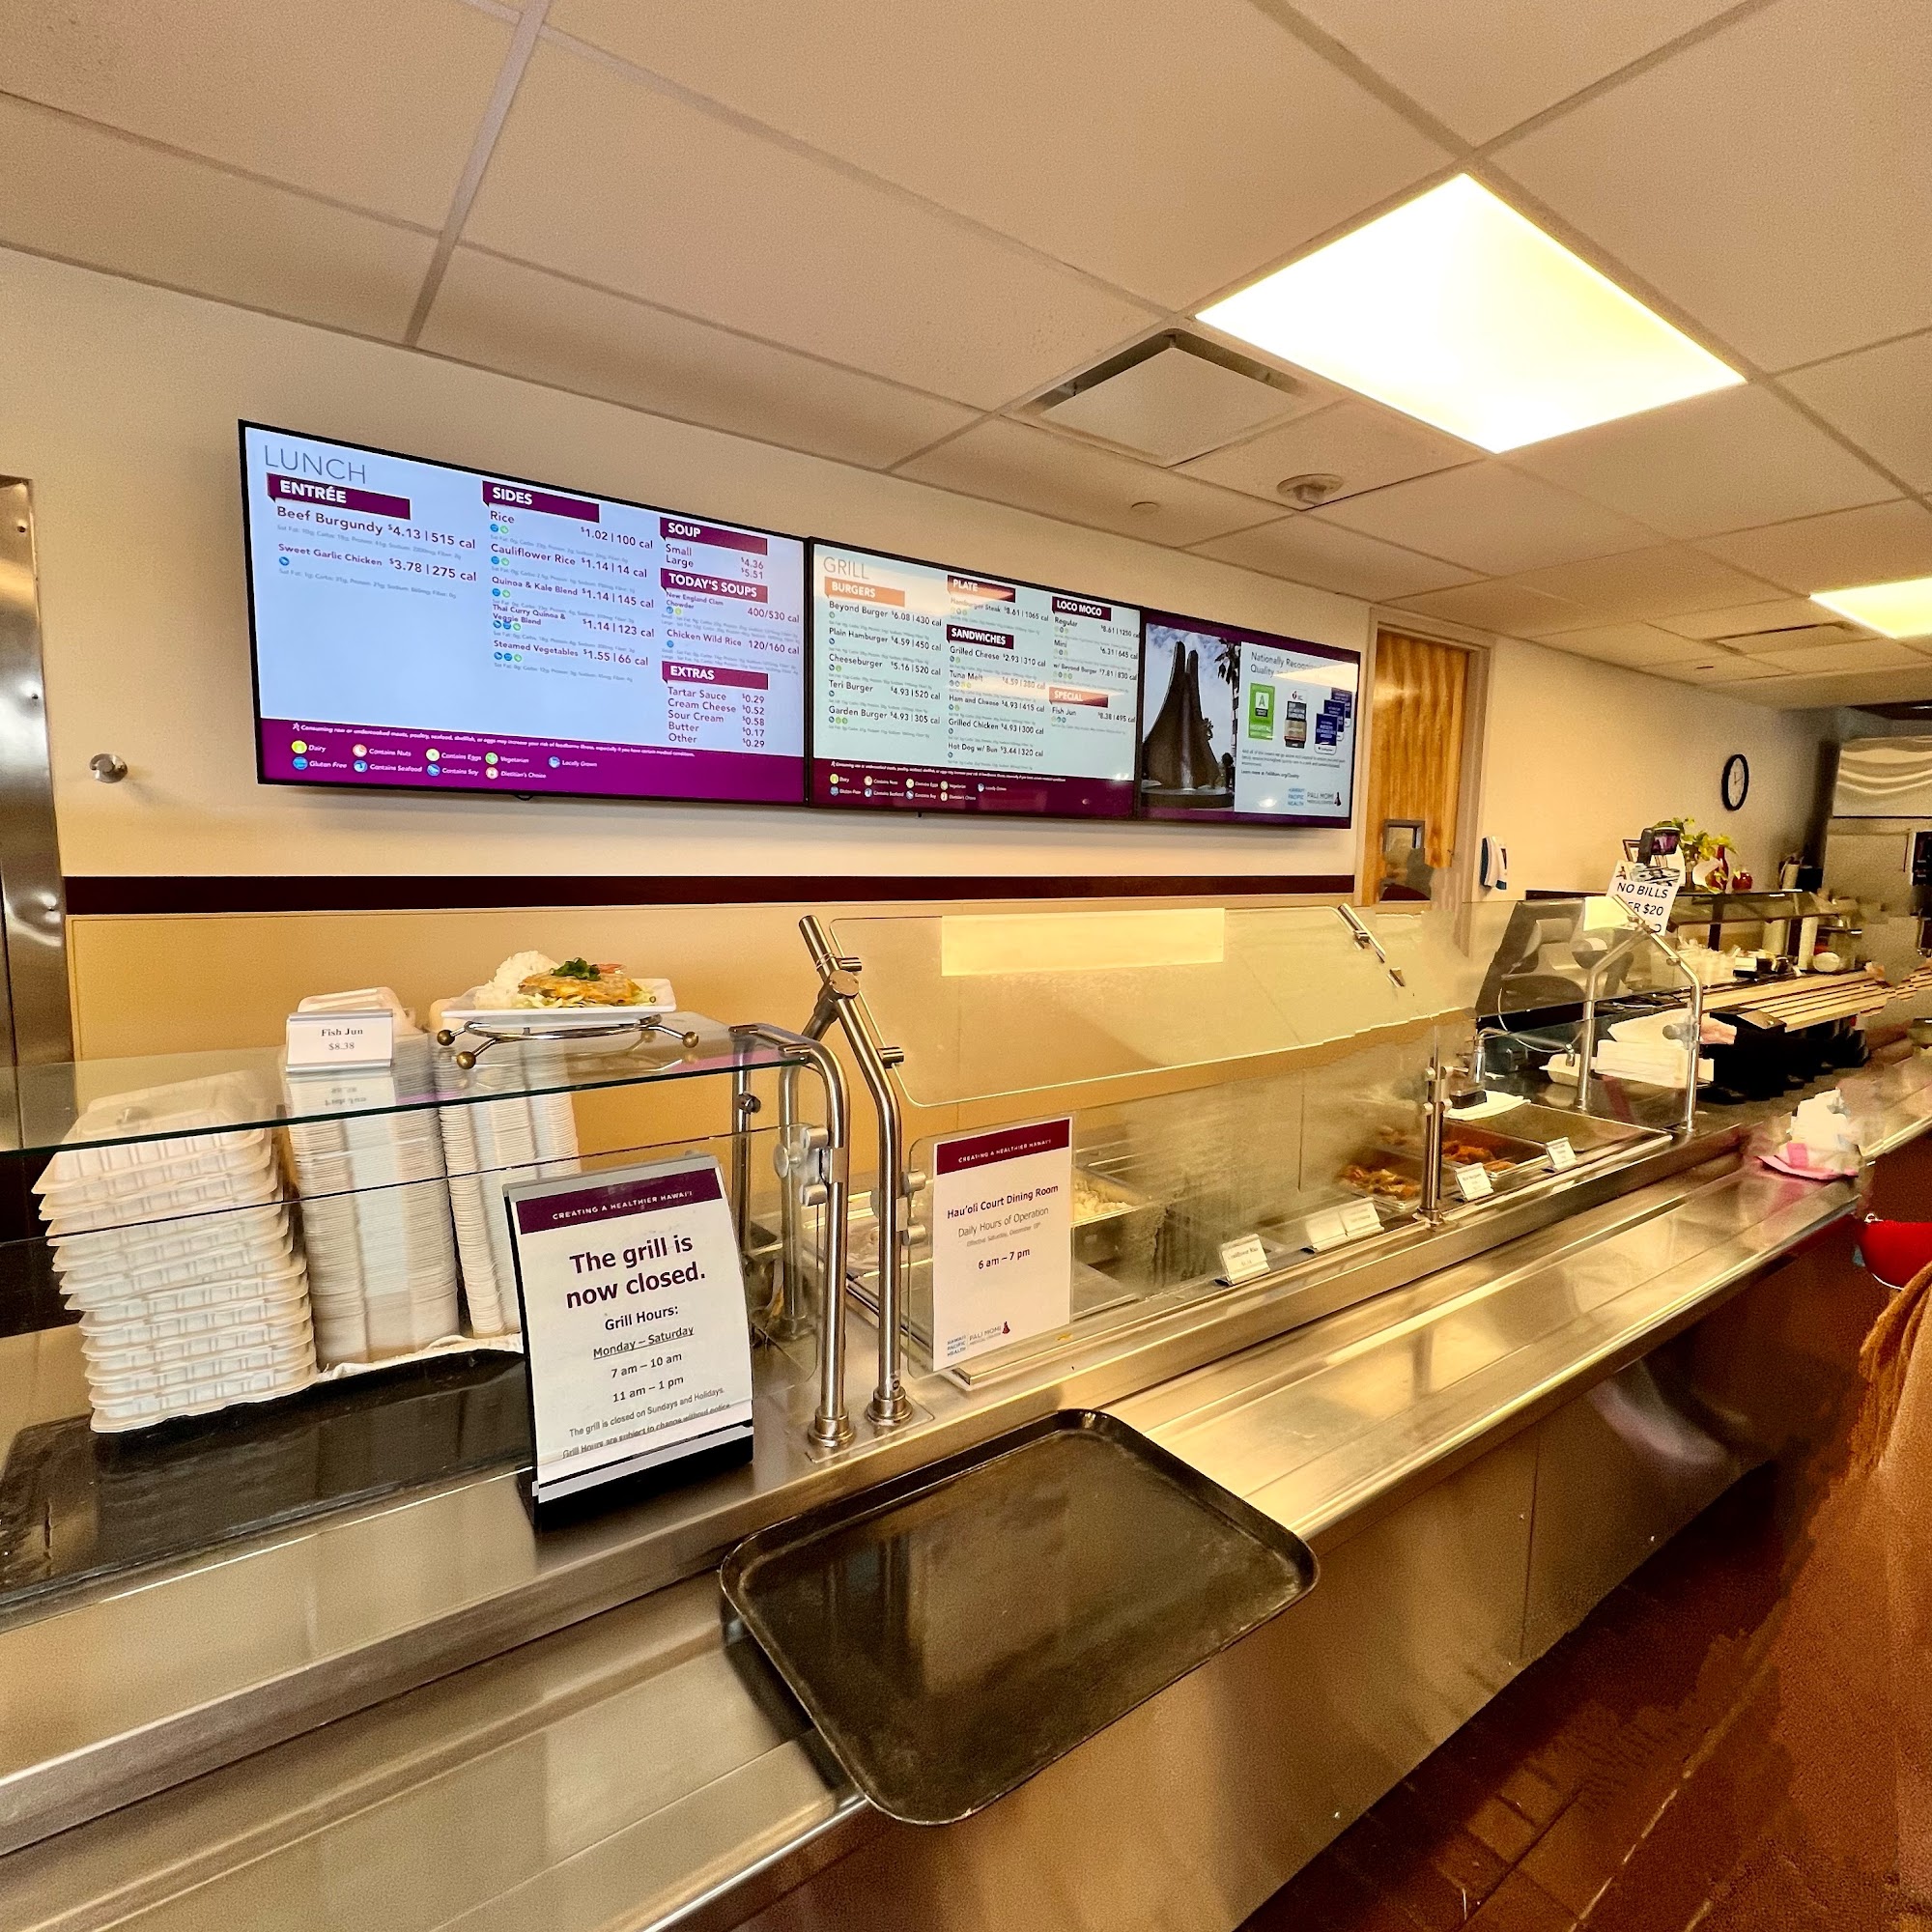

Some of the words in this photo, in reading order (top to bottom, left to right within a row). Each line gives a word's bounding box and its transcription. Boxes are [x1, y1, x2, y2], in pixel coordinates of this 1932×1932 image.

[265, 445, 365, 484] LUNCH
[280, 480, 346, 503] ENTRÉE
[493, 487, 532, 505] SIDES
[491, 511, 515, 524] Rice
[277, 506, 309, 522] Beef
[316, 513, 383, 535] Burgundy
[432, 530, 454, 545] 515
[460, 534, 475, 549] cal
[668, 523, 700, 538] SOUP
[617, 534, 636, 546] 100
[639, 539, 653, 549] cal
[666, 544, 692, 556] Small
[278, 544, 309, 555] Sweet
[314, 548, 342, 560] Garlic
[345, 553, 382, 566] Chicken
[433, 566, 455, 579] 275
[460, 569, 476, 582] cal
[491, 544, 551, 561] Cauliflower
[554, 554, 575, 565] Rice
[618, 564, 629, 574] 14
[634, 568, 647, 578] cal
[666, 554, 694, 568] Large
[824, 556, 868, 580] GRILL
[492, 577, 523, 587] Quinoa
[535, 582, 553, 591] Kale
[555, 585, 578, 596] Blend
[618, 594, 637, 606] 145
[640, 598, 654, 608] cal
[668, 572, 718, 591] TODAY'S
[721, 582, 757, 598] SOUPS
[832, 582, 875, 598] BURGERS
[953, 581, 979, 592] PLATE
[748, 607, 784, 621] 400/530
[787, 614, 799, 623] cal
[829, 601, 859, 614] Beyond
[863, 607, 888, 618] Burger
[916, 615, 929, 624] 430
[1057, 600, 1077, 611] LOCO
[1079, 605, 1101, 616] MOCO
[618, 624, 637, 635] 123
[640, 628, 654, 637] cal
[829, 628, 846, 637] Plain
[849, 630, 888, 643] Hamburger
[916, 640, 929, 649] 450
[952, 628, 1006, 645] SANDWICHES
[667, 629, 700, 641] Chicken
[703, 635, 722, 644] Wild
[725, 638, 742, 647] Rice
[749, 640, 785, 653] 120/160
[787, 645, 799, 655] cal
[494, 640, 530, 651] Steamed
[533, 644, 579, 657] Vegetables
[619, 654, 630, 663] 66
[635, 657, 648, 666] cal
[950, 646, 973, 656] Grilled
[975, 649, 999, 660] Cheese
[1024, 657, 1035, 666] 310
[1251, 651, 1284, 668] Nationally
[829, 654, 883, 668] Cheeseburger
[916, 665, 928, 674] 520
[1250, 665, 1274, 678] Quality
[670, 666, 715, 681] EXTRAS
[668, 686, 696, 698] Tartar
[700, 690, 726, 701] Sauce
[829, 680, 843, 689] Teri
[846, 682, 873, 693] Burger
[915, 690, 928, 698] 520
[1054, 691, 1082, 700] SPECIAL
[668, 698, 699, 709] Cream
[702, 701, 736, 713] Cheese
[668, 710, 691, 721] Sour
[694, 713, 724, 723] Cream
[829, 706, 858, 717] Garden
[861, 709, 887, 719] Burger
[915, 715, 927, 724] 305
[668, 722, 699, 732] Butter
[949, 719, 971, 728] Grilled
[974, 721, 999, 730] Chicken
[668, 732, 696, 744] Other
[1617, 883, 1634, 893] NO
[1637, 886, 1668, 898] BILLS
[1643, 903, 1663, 916] $20
[322, 1028, 342, 1037] Fish
[980, 1198, 1004, 1210] Court
[1007, 1192, 1033, 1205] Dining
[1036, 1185, 1058, 1197] Room
[553, 1207, 598, 1220] CREATING
[611, 1197, 658, 1209] HEALTHIER
[958, 1225, 977, 1237] Daily
[980, 1218, 1002, 1231] Hours
[1005, 1215, 1011, 1224] of
[1013, 1208, 1048, 1223] Operation
[569, 1250, 616, 1274] The
[623, 1236, 668, 1268] grill
[673, 1235, 693, 1253] is
[979, 1260, 983, 1269] 6
[986, 1258, 999, 1266] am
[1017, 1248, 1030, 1259] pm
[567, 1283, 618, 1309] now
[626, 1262, 705, 1294] closed.
[605, 1312, 632, 1330] Grill
[637, 1306, 678, 1323] Hours:
[593, 1340, 636, 1359] Monday
[648, 1326, 695, 1344] Saturday
[611, 1369, 617, 1378] 7
[621, 1365, 638, 1376] am
[650, 1359, 663, 1369] 10
[667, 1353, 682, 1364] am
[613, 1393, 625, 1403] 11
[629, 1387, 645, 1398] am
[659, 1380, 665, 1389] 1
[668, 1376, 684, 1389] pm
[570, 1428, 583, 1437] The
[585, 1421, 600, 1435] grill
[602, 1419, 609, 1428] is
[611, 1413, 634, 1425] closed
[647, 1401, 678, 1415] Sundays
[680, 1396, 692, 1406] and
[695, 1387, 724, 1401] Holidays.
